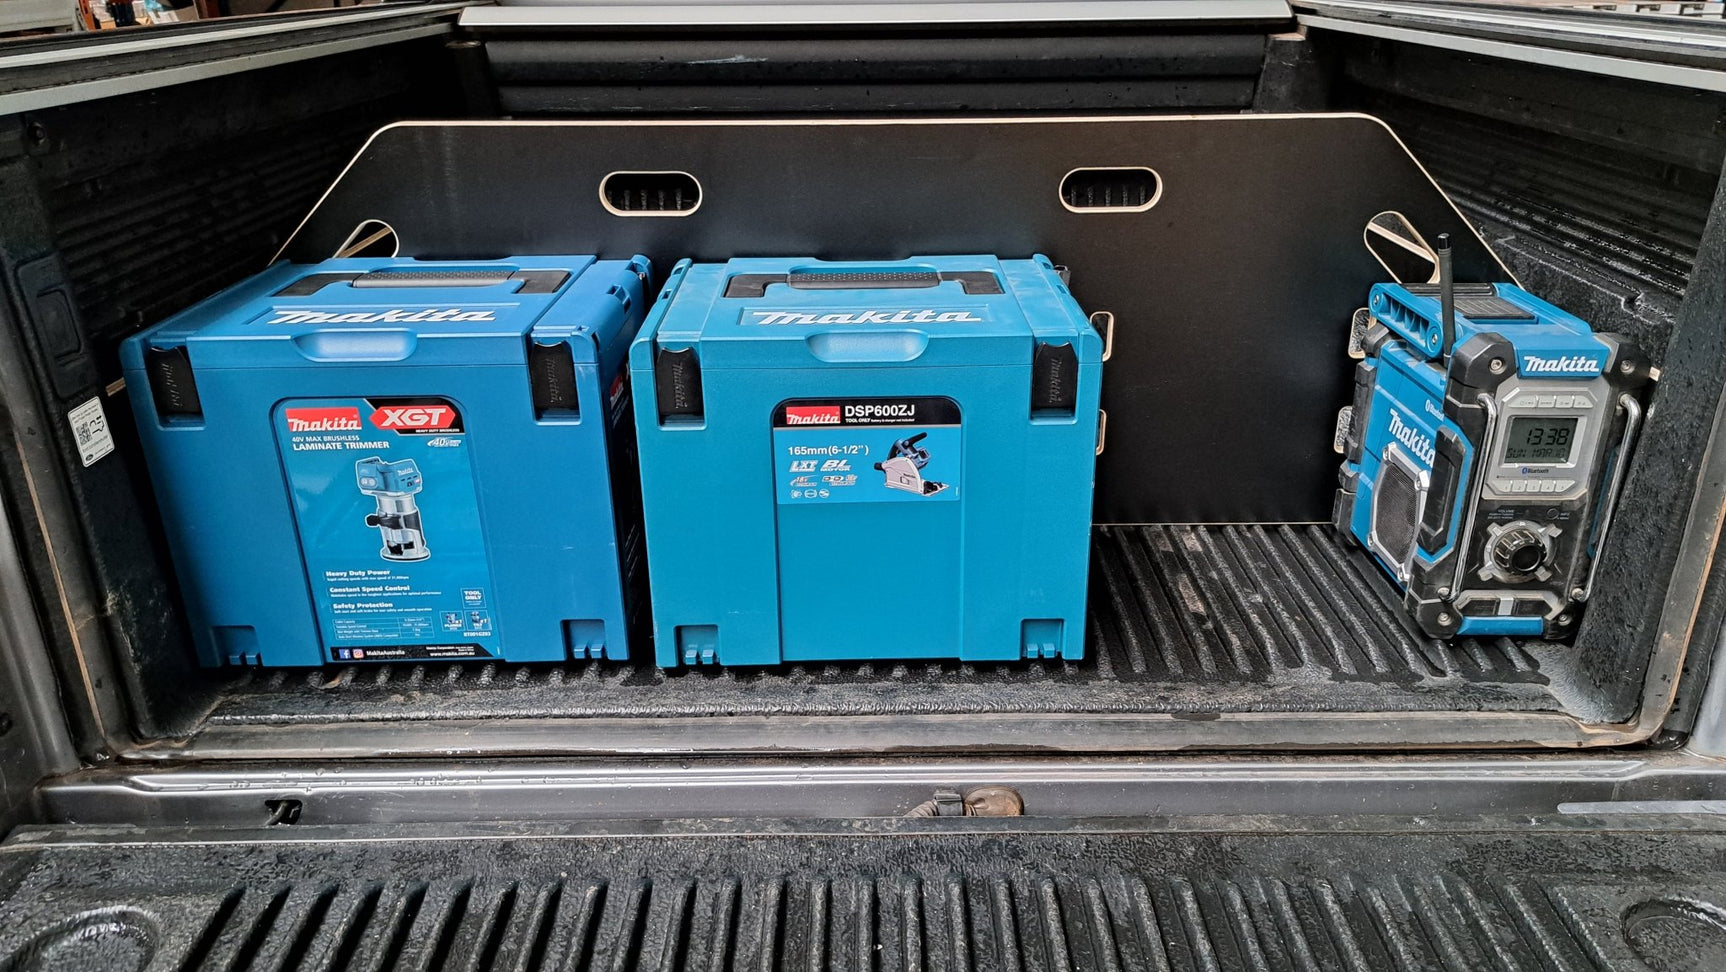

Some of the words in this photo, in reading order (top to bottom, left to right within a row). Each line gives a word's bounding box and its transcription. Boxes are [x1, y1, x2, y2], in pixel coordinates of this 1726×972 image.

[845, 405, 915, 417] DSP600ZJ
[380, 408, 446, 427] XGT
[293, 442, 342, 451] LAMINATE
[345, 441, 390, 449] TRIMMER
[1506, 447, 1528, 459] SUN
[1531, 447, 1553, 458] MAR
[791, 460, 818, 470] LXT
[822, 459, 848, 468] BL
